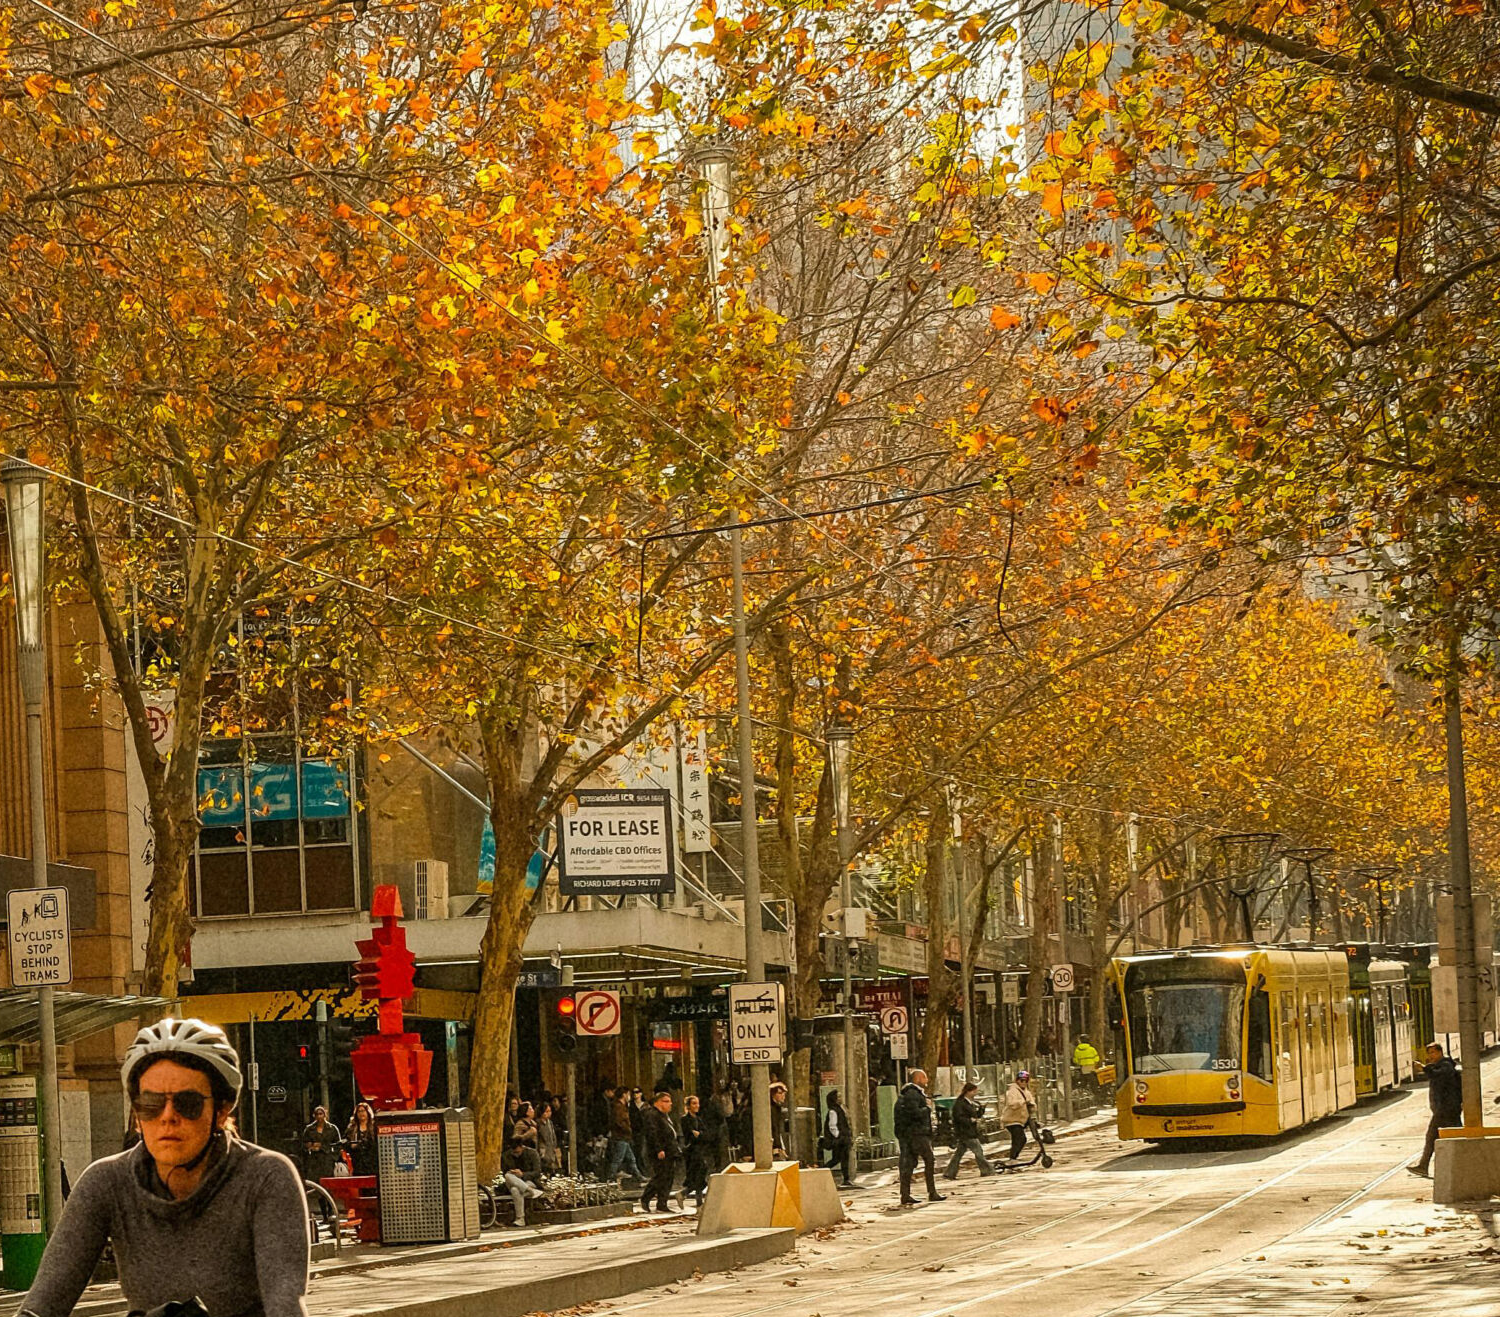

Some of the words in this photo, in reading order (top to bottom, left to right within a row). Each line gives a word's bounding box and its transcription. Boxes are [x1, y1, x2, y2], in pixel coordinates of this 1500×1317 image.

[1324, 516, 1342, 528] 197
[569, 820, 603, 837] FOR
[608, 820, 660, 836] LEASE
[570, 846, 613, 856] Affordable
[615, 846, 632, 855] CBD
[633, 845, 662, 855] Offices
[573, 880, 602, 888] RICHARD
[14, 929, 64, 943] CYCLISTS
[27, 943, 53, 954] STOP
[21, 956, 60, 968] BEHIND
[23, 970, 60, 982] TRAMS
[1056, 973, 1070, 982] 30
[737, 1023, 774, 1039] ONLY
[743, 1050, 770, 1060] END
[1211, 1058, 1237, 1070] 3530
